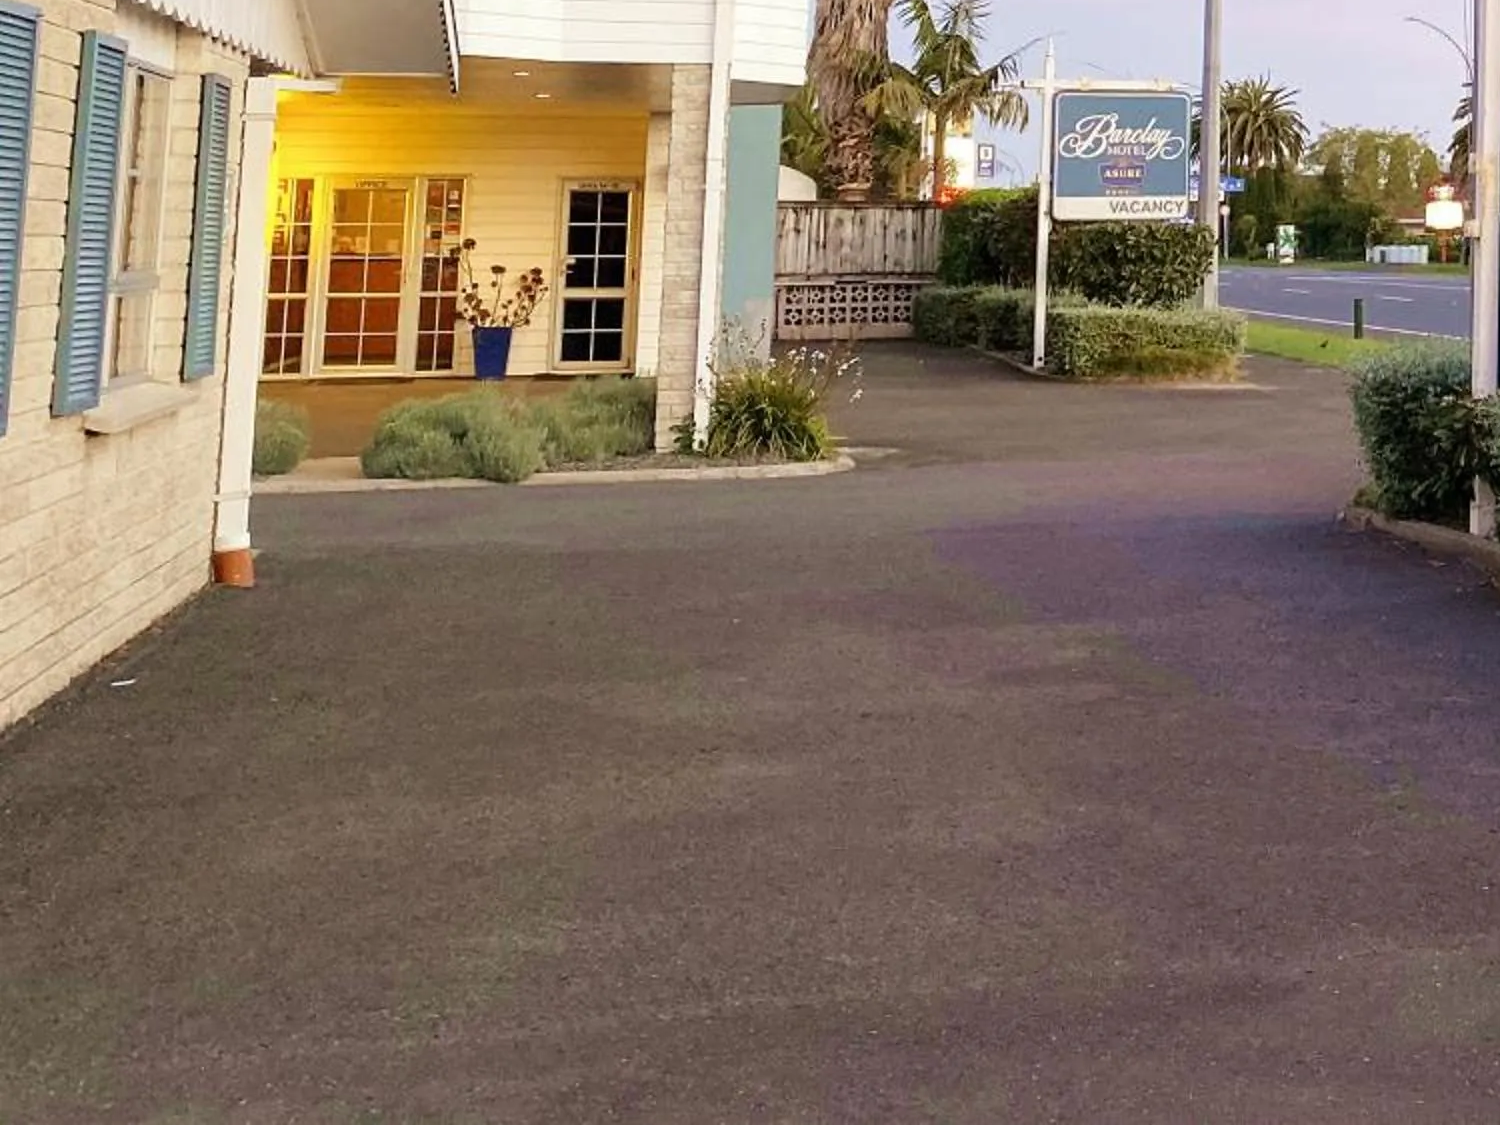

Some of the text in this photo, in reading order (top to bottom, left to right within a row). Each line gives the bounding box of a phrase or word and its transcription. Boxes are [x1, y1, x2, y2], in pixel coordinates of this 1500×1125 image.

[1060, 113, 1185, 160] Barclay
[1107, 145, 1147, 156] MOTEL
[1109, 200, 1184, 214] VACANCY
